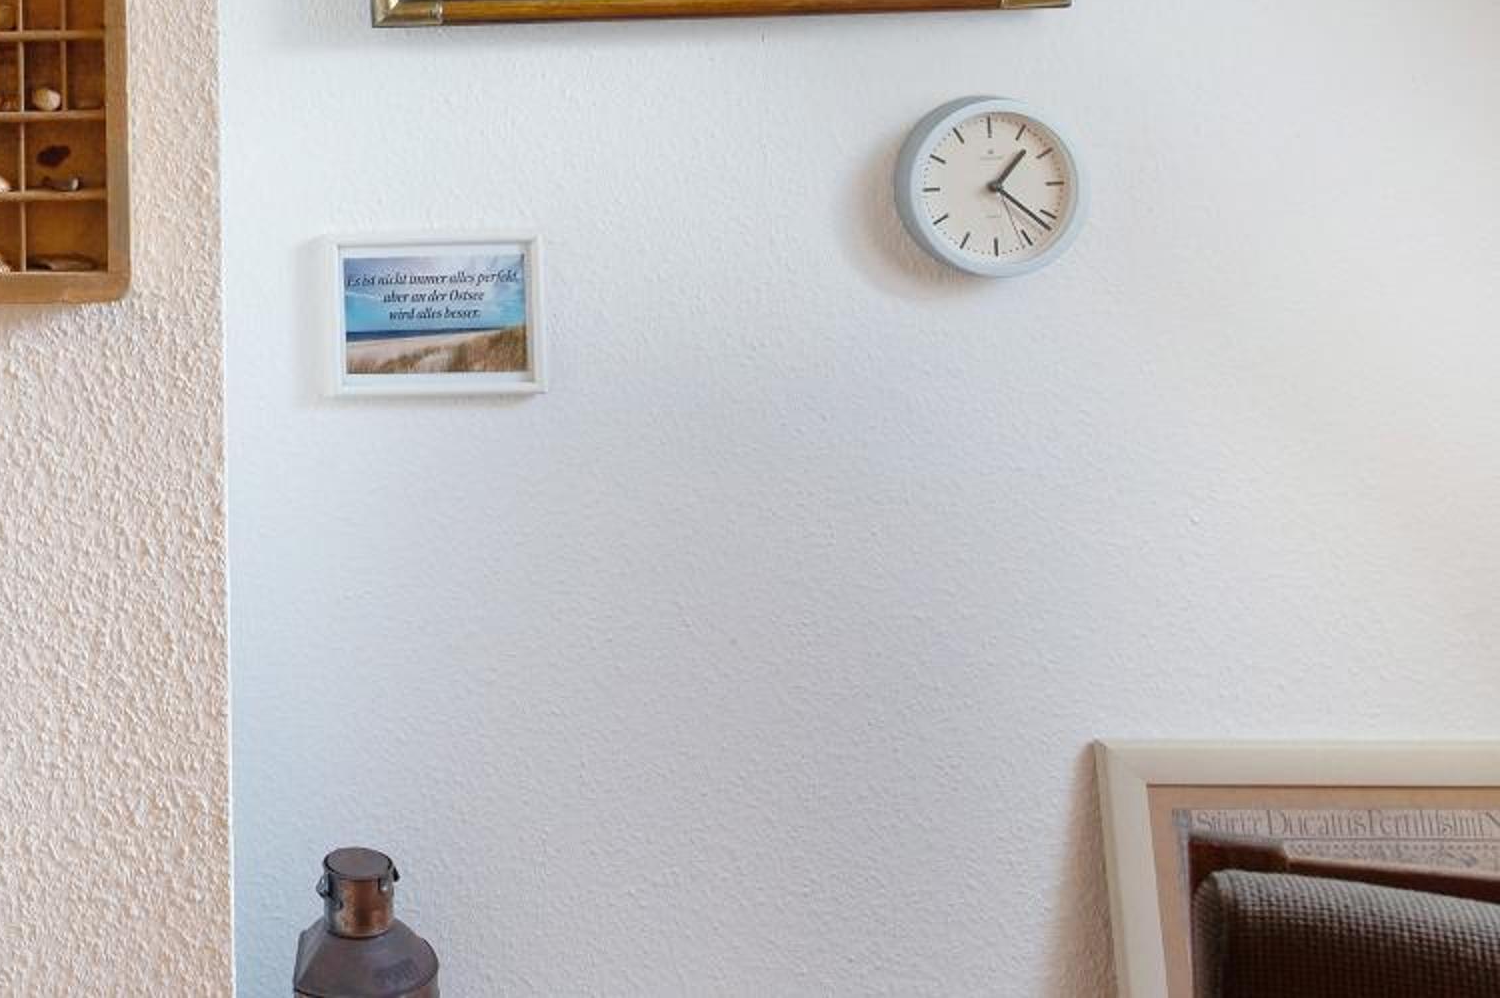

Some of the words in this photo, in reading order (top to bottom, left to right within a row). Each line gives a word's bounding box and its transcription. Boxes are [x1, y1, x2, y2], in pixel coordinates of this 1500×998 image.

[408, 273, 448, 285] immer
[448, 270, 476, 284] alles
[382, 290, 410, 303] aber
[411, 293, 427, 303] an
[426, 289, 449, 302] der
[449, 288, 485, 302] Ostsee
[388, 307, 416, 320] wird
[415, 306, 442, 320] alles
